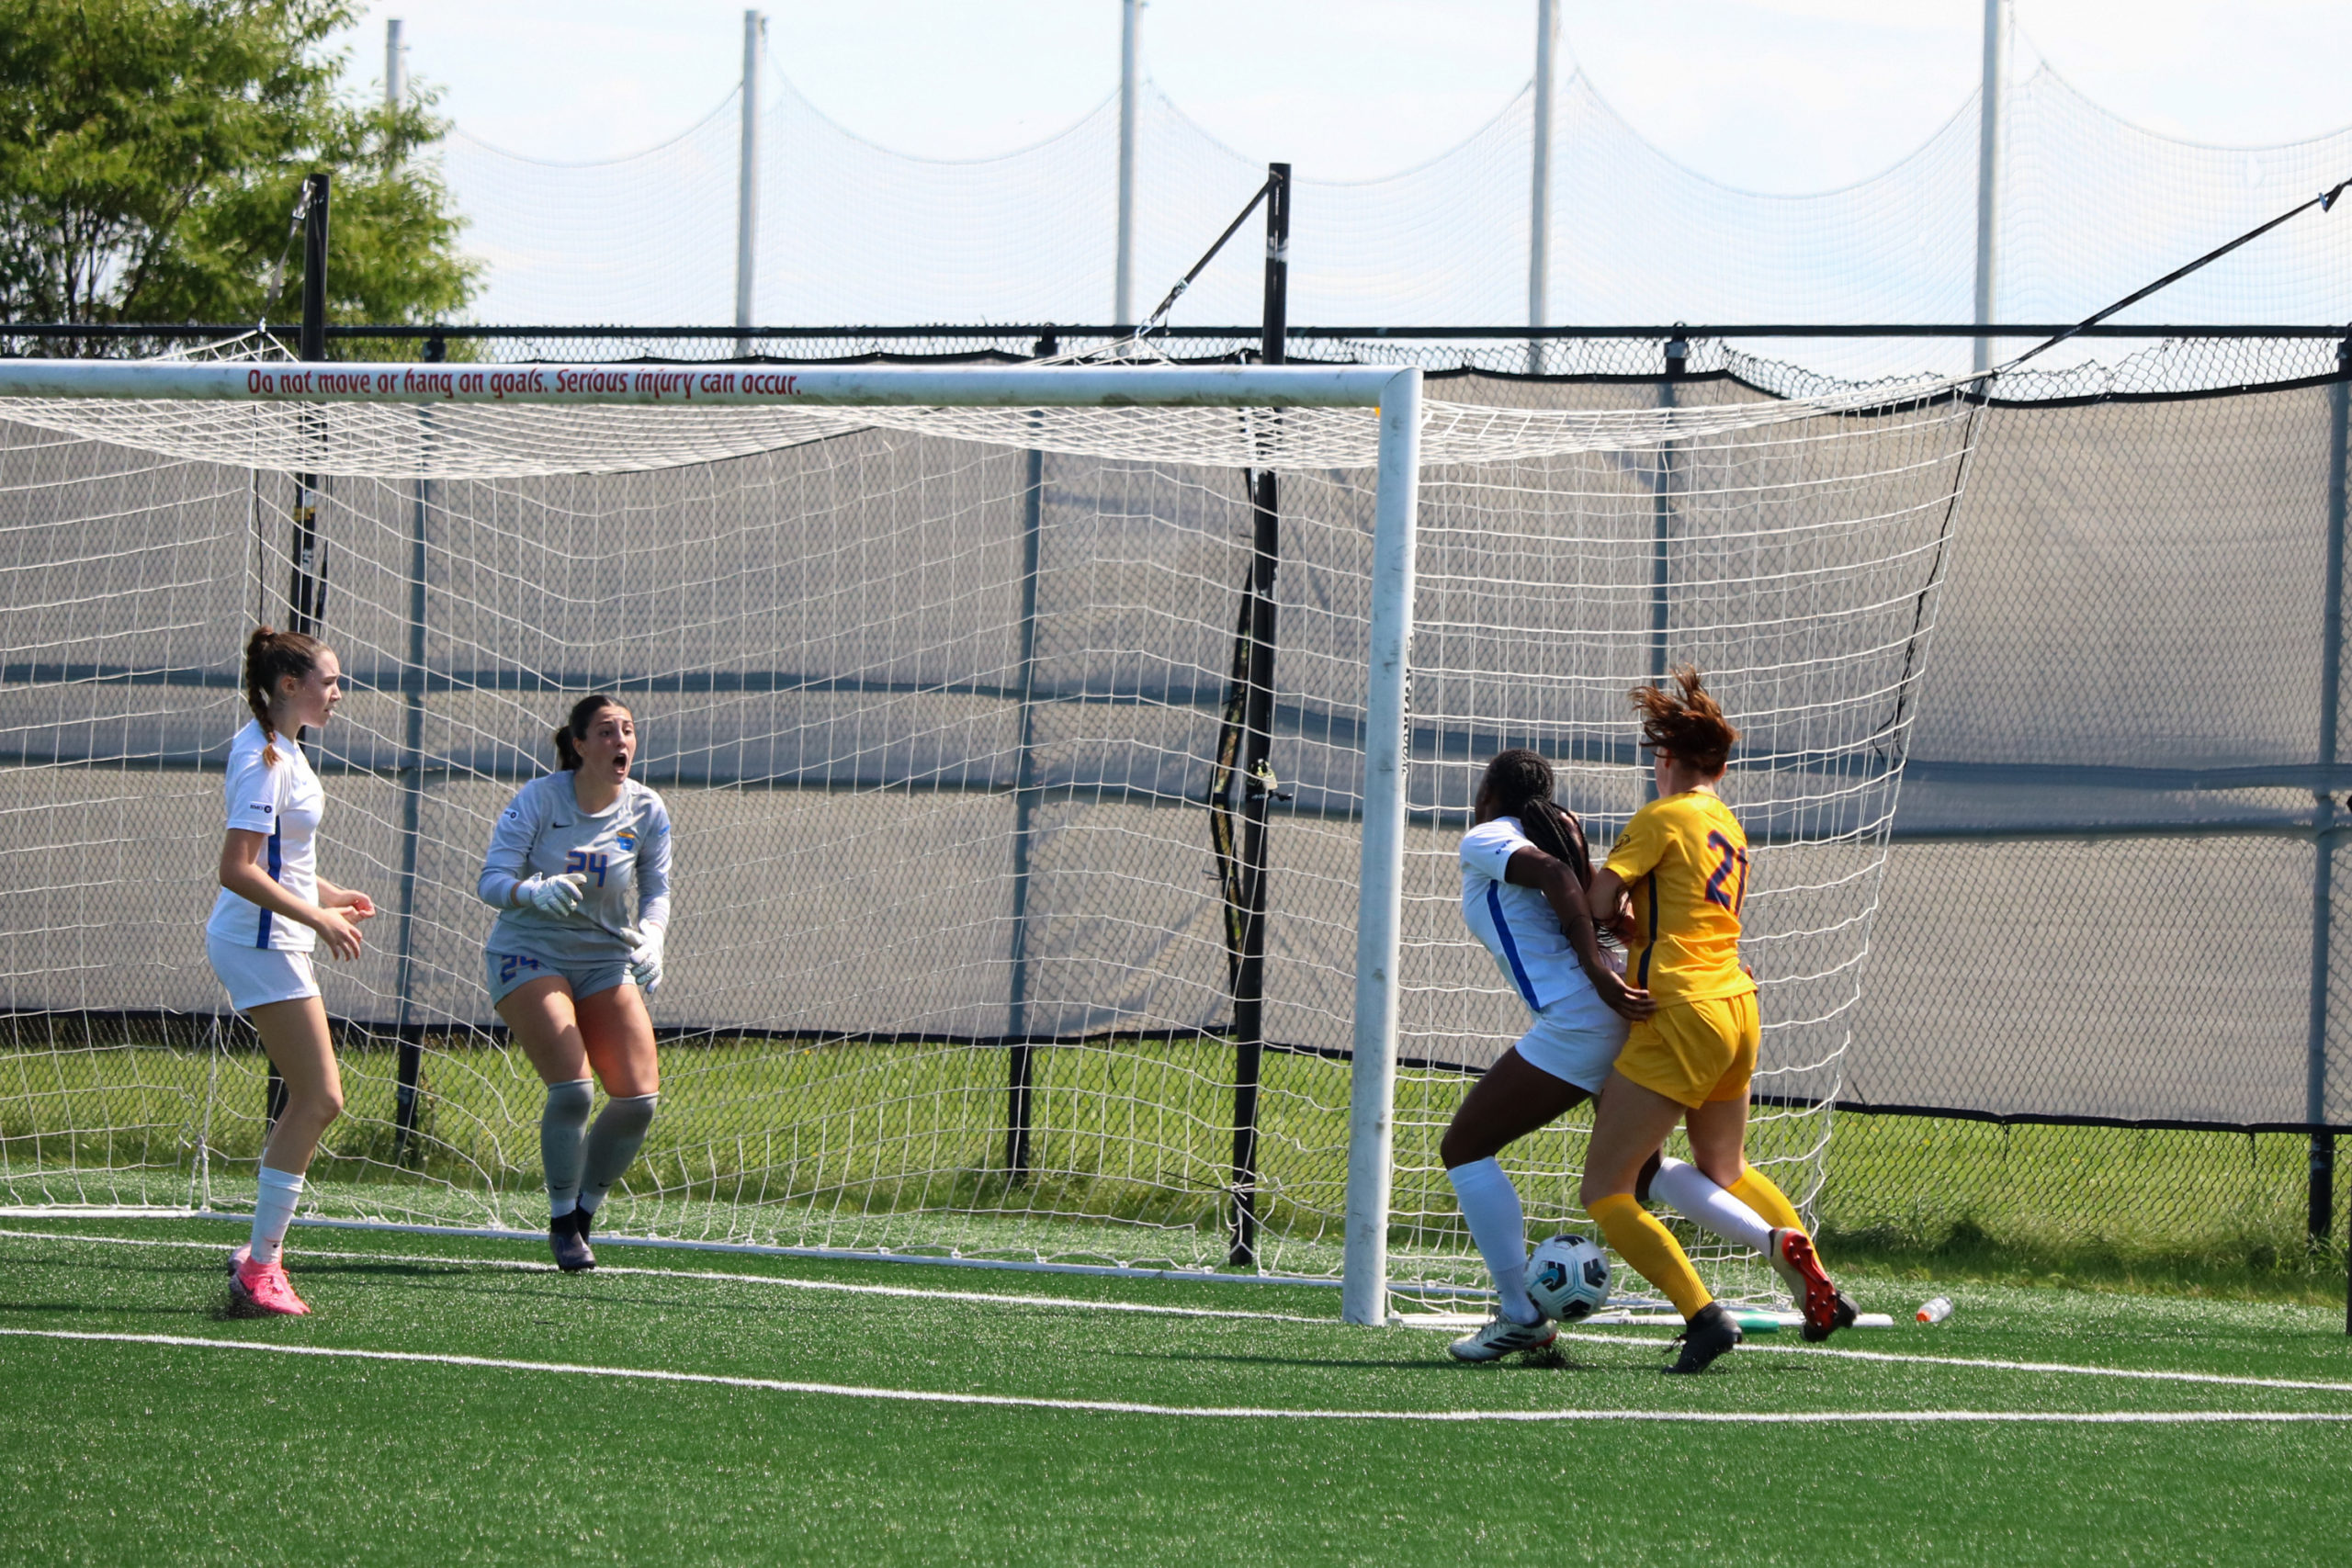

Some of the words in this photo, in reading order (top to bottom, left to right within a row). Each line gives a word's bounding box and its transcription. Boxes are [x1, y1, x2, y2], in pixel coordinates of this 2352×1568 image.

[247, 369, 274, 394] Do
[280, 370, 313, 394] not
[318, 373, 371, 394] move
[377, 373, 399, 394] or
[404, 368, 454, 399] hang
[459, 373, 483, 393] on
[490, 368, 548, 399] goals.
[555, 368, 628, 394] Serious
[635, 368, 695, 400] injury
[700, 371, 734, 393] can
[741, 373, 801, 395] occur.
[566, 851, 608, 888] 24
[1704, 829, 1747, 918] 21
